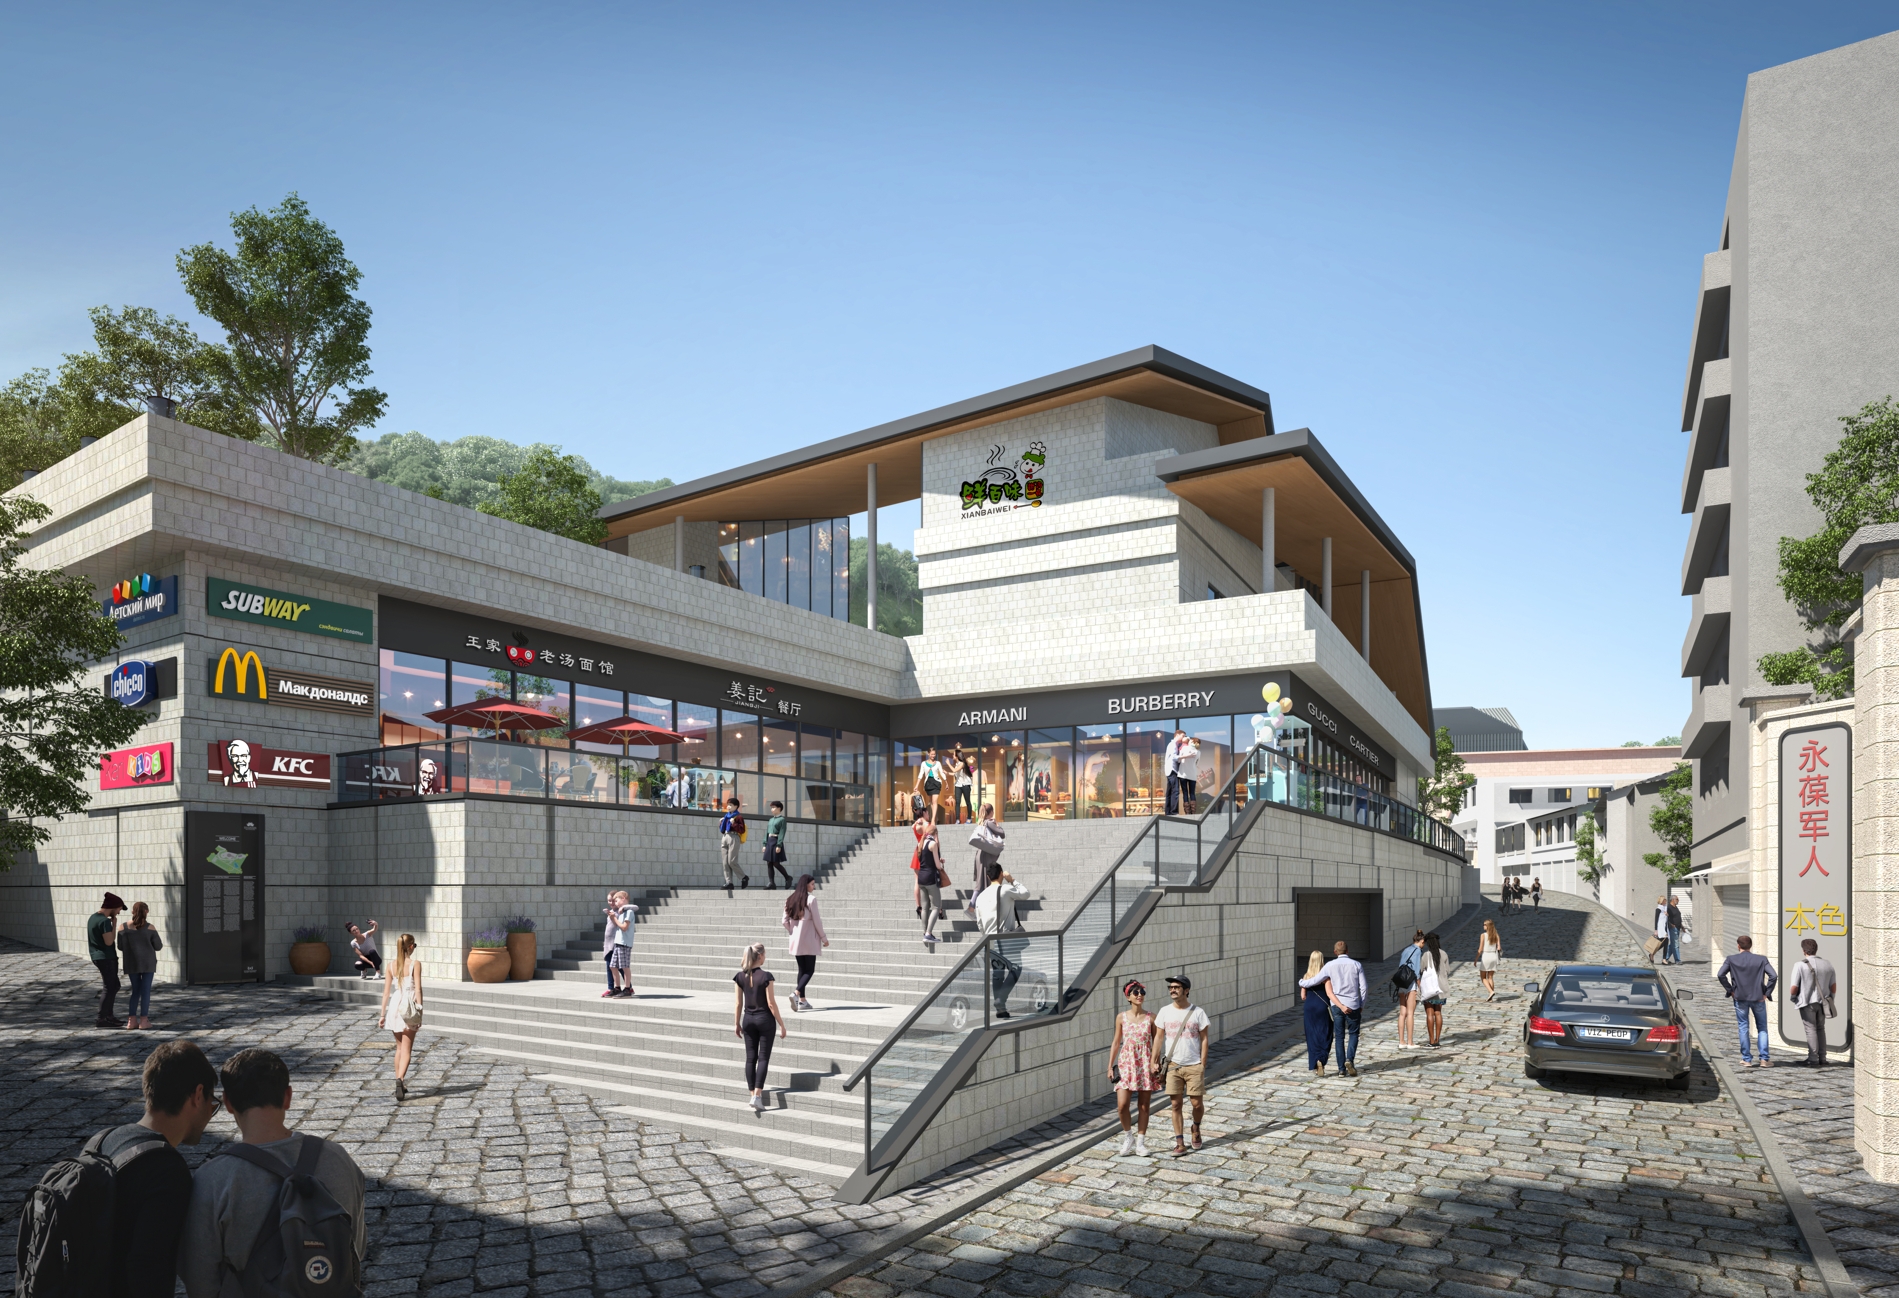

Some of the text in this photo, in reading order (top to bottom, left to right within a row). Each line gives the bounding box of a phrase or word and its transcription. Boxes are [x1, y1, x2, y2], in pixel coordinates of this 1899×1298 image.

[960, 478, 1024, 510] 鲜百味
[961, 505, 1011, 520] XIANBAIWEI
[109, 593, 163, 619] Детский мир
[221, 590, 311, 621] SUBWAY
[466, 635, 614, 675] 王家 老汤面馆
[114, 668, 143, 697] chicco
[278, 680, 369, 706] Макдоналдс
[777, 700, 801, 716] 餐厅
[958, 707, 1028, 727] ARMANI
[1108, 691, 1215, 715] BURBERRY
[1307, 702, 1338, 734] GUCCI
[272, 756, 314, 774] KFC
[1349, 735, 1379, 766] CARTIER
[1798, 739, 1830, 877] 永葆军人
[1784, 902, 1848, 936] 本色
